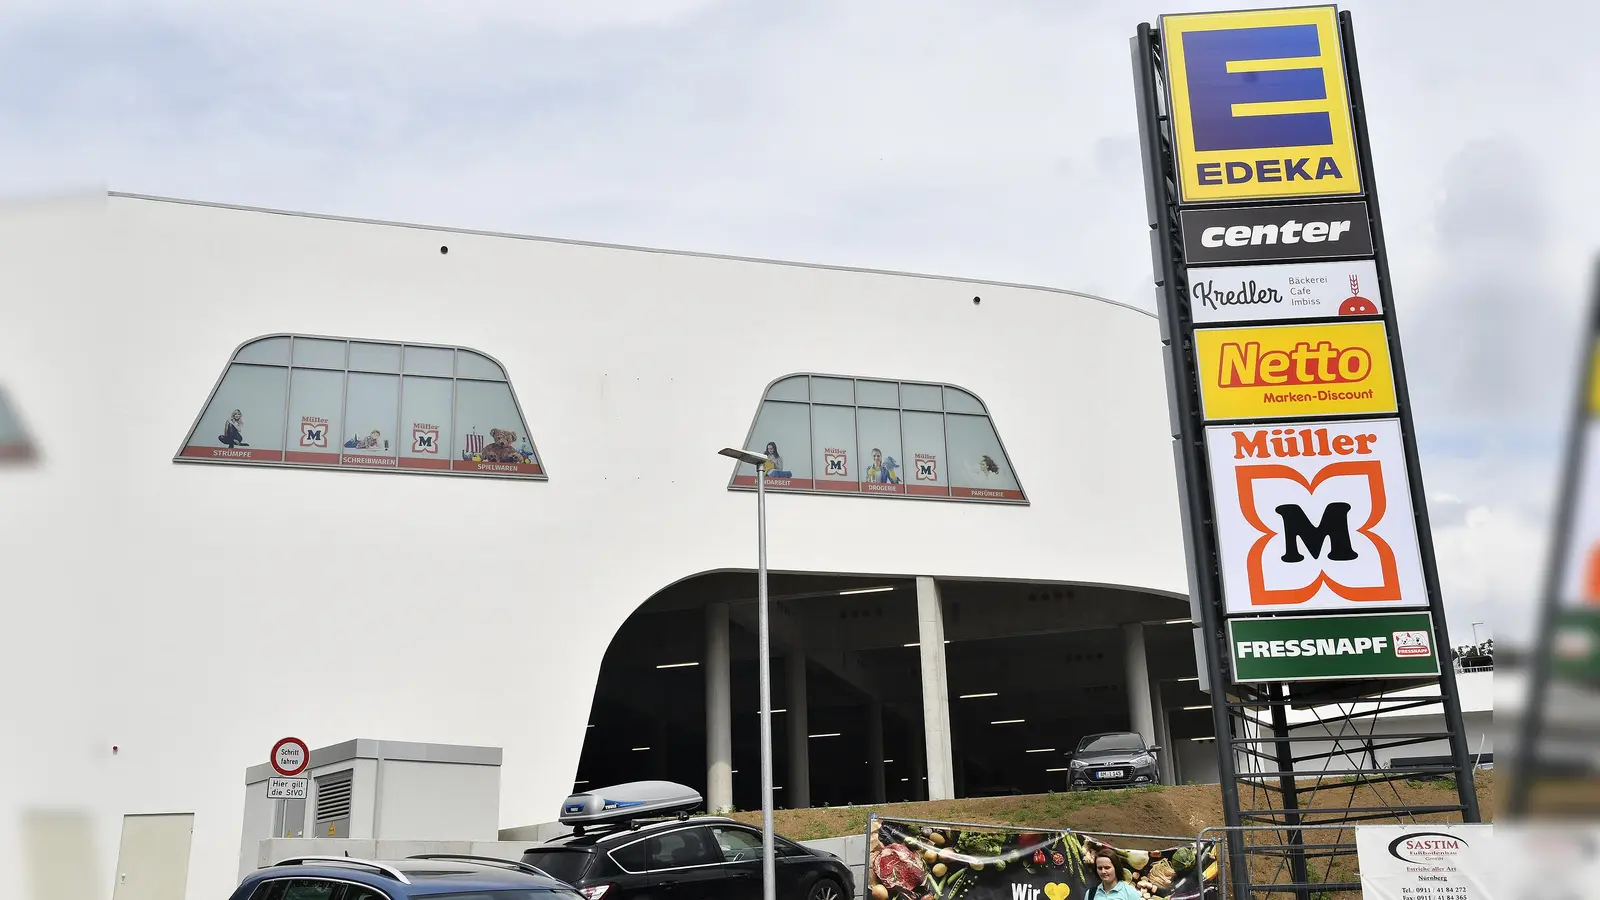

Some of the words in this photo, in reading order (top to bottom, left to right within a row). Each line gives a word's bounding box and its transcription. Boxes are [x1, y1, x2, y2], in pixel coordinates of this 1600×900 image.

[1181, 24, 1333, 151] E
[1196, 156, 1343, 186] EDEKA
[1201, 219, 1351, 248] center
[1288, 275, 1328, 285] Bäckerei
[1192, 279, 1283, 310] Kredler
[1290, 287, 1311, 296] Cafe
[1291, 298, 1321, 306] Imbiss
[1217, 341, 1372, 388] Netto
[1263, 388, 1374, 404] Marken-Discount
[302, 416, 329, 424] Müller
[413, 422, 440, 430] Müller
[307, 429, 322, 441] M
[418, 436, 432, 447] M
[1231, 428, 1378, 460] Müller
[342, 456, 396, 466] SCHREIBWAREN
[477, 463, 518, 472] SPIELWAREN
[754, 478, 791, 486] HNDARBEIT
[868, 484, 897, 492] DROGERIE
[1275, 502, 1359, 563] M
[1237, 637, 1388, 659] FRESSNAPF
[291, 780, 303, 789] gilt
[1406, 840, 1459, 850] SASTIM
[1011, 882, 1041, 900] Wir
